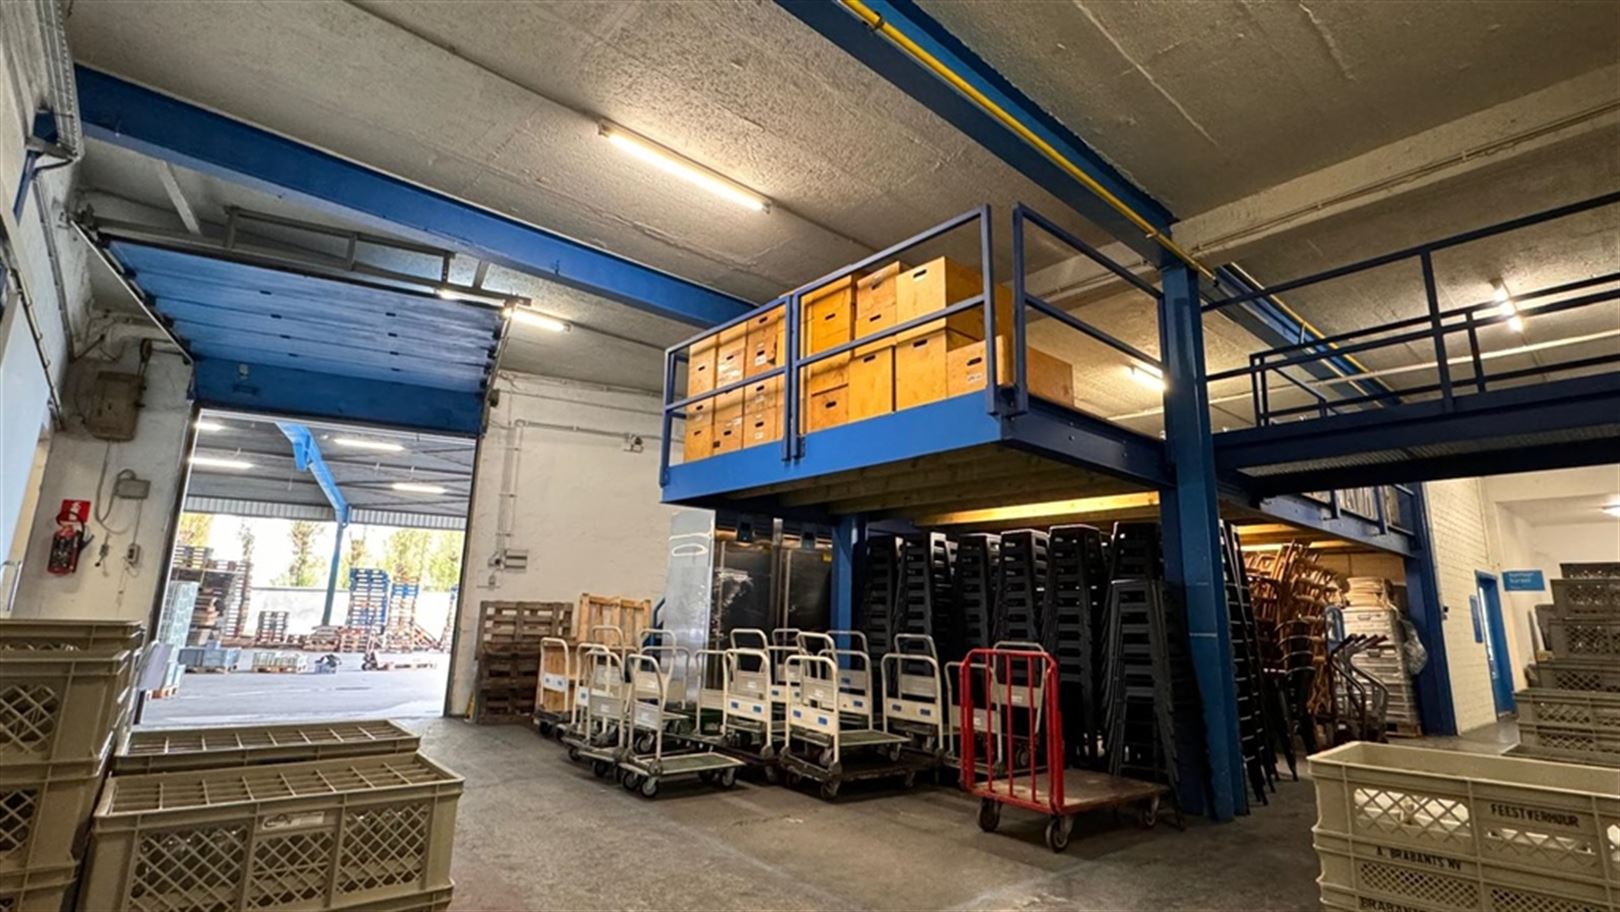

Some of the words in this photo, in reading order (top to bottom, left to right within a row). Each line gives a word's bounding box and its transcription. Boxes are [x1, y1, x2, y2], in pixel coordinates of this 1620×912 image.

[1490, 803, 1579, 827] FEESTVERHUUR
[1447, 857, 1461, 871] NV
[1358, 896, 1427, 912] BRABAN
